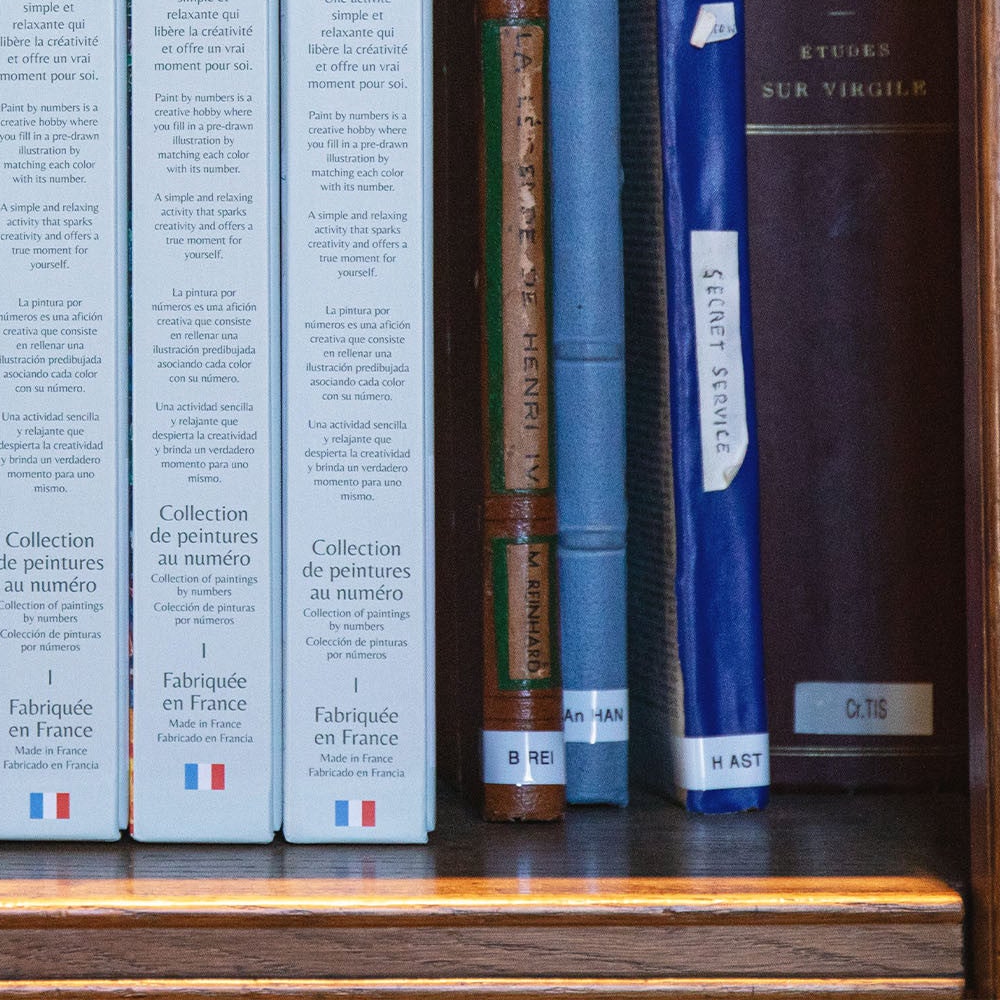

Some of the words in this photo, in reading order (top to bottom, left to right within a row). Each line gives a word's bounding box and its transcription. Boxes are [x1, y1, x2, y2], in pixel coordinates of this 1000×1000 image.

[761, 81, 809, 99] SUR
[823, 79, 927, 98] VIRGILE
[701, 268, 726, 352] SECRET
[523, 332, 540, 430] HENRI
[711, 366, 731, 455] SERVICE
[528, 551, 541, 568] M
[526, 579, 542, 673] REINHARD
[564, 708, 585, 723] An
[591, 707, 624, 723] HAN
[508, 750, 520, 766] B
[528, 750, 555, 766] REI
[712, 755, 724, 770] H
[729, 752, 764, 769] AST
